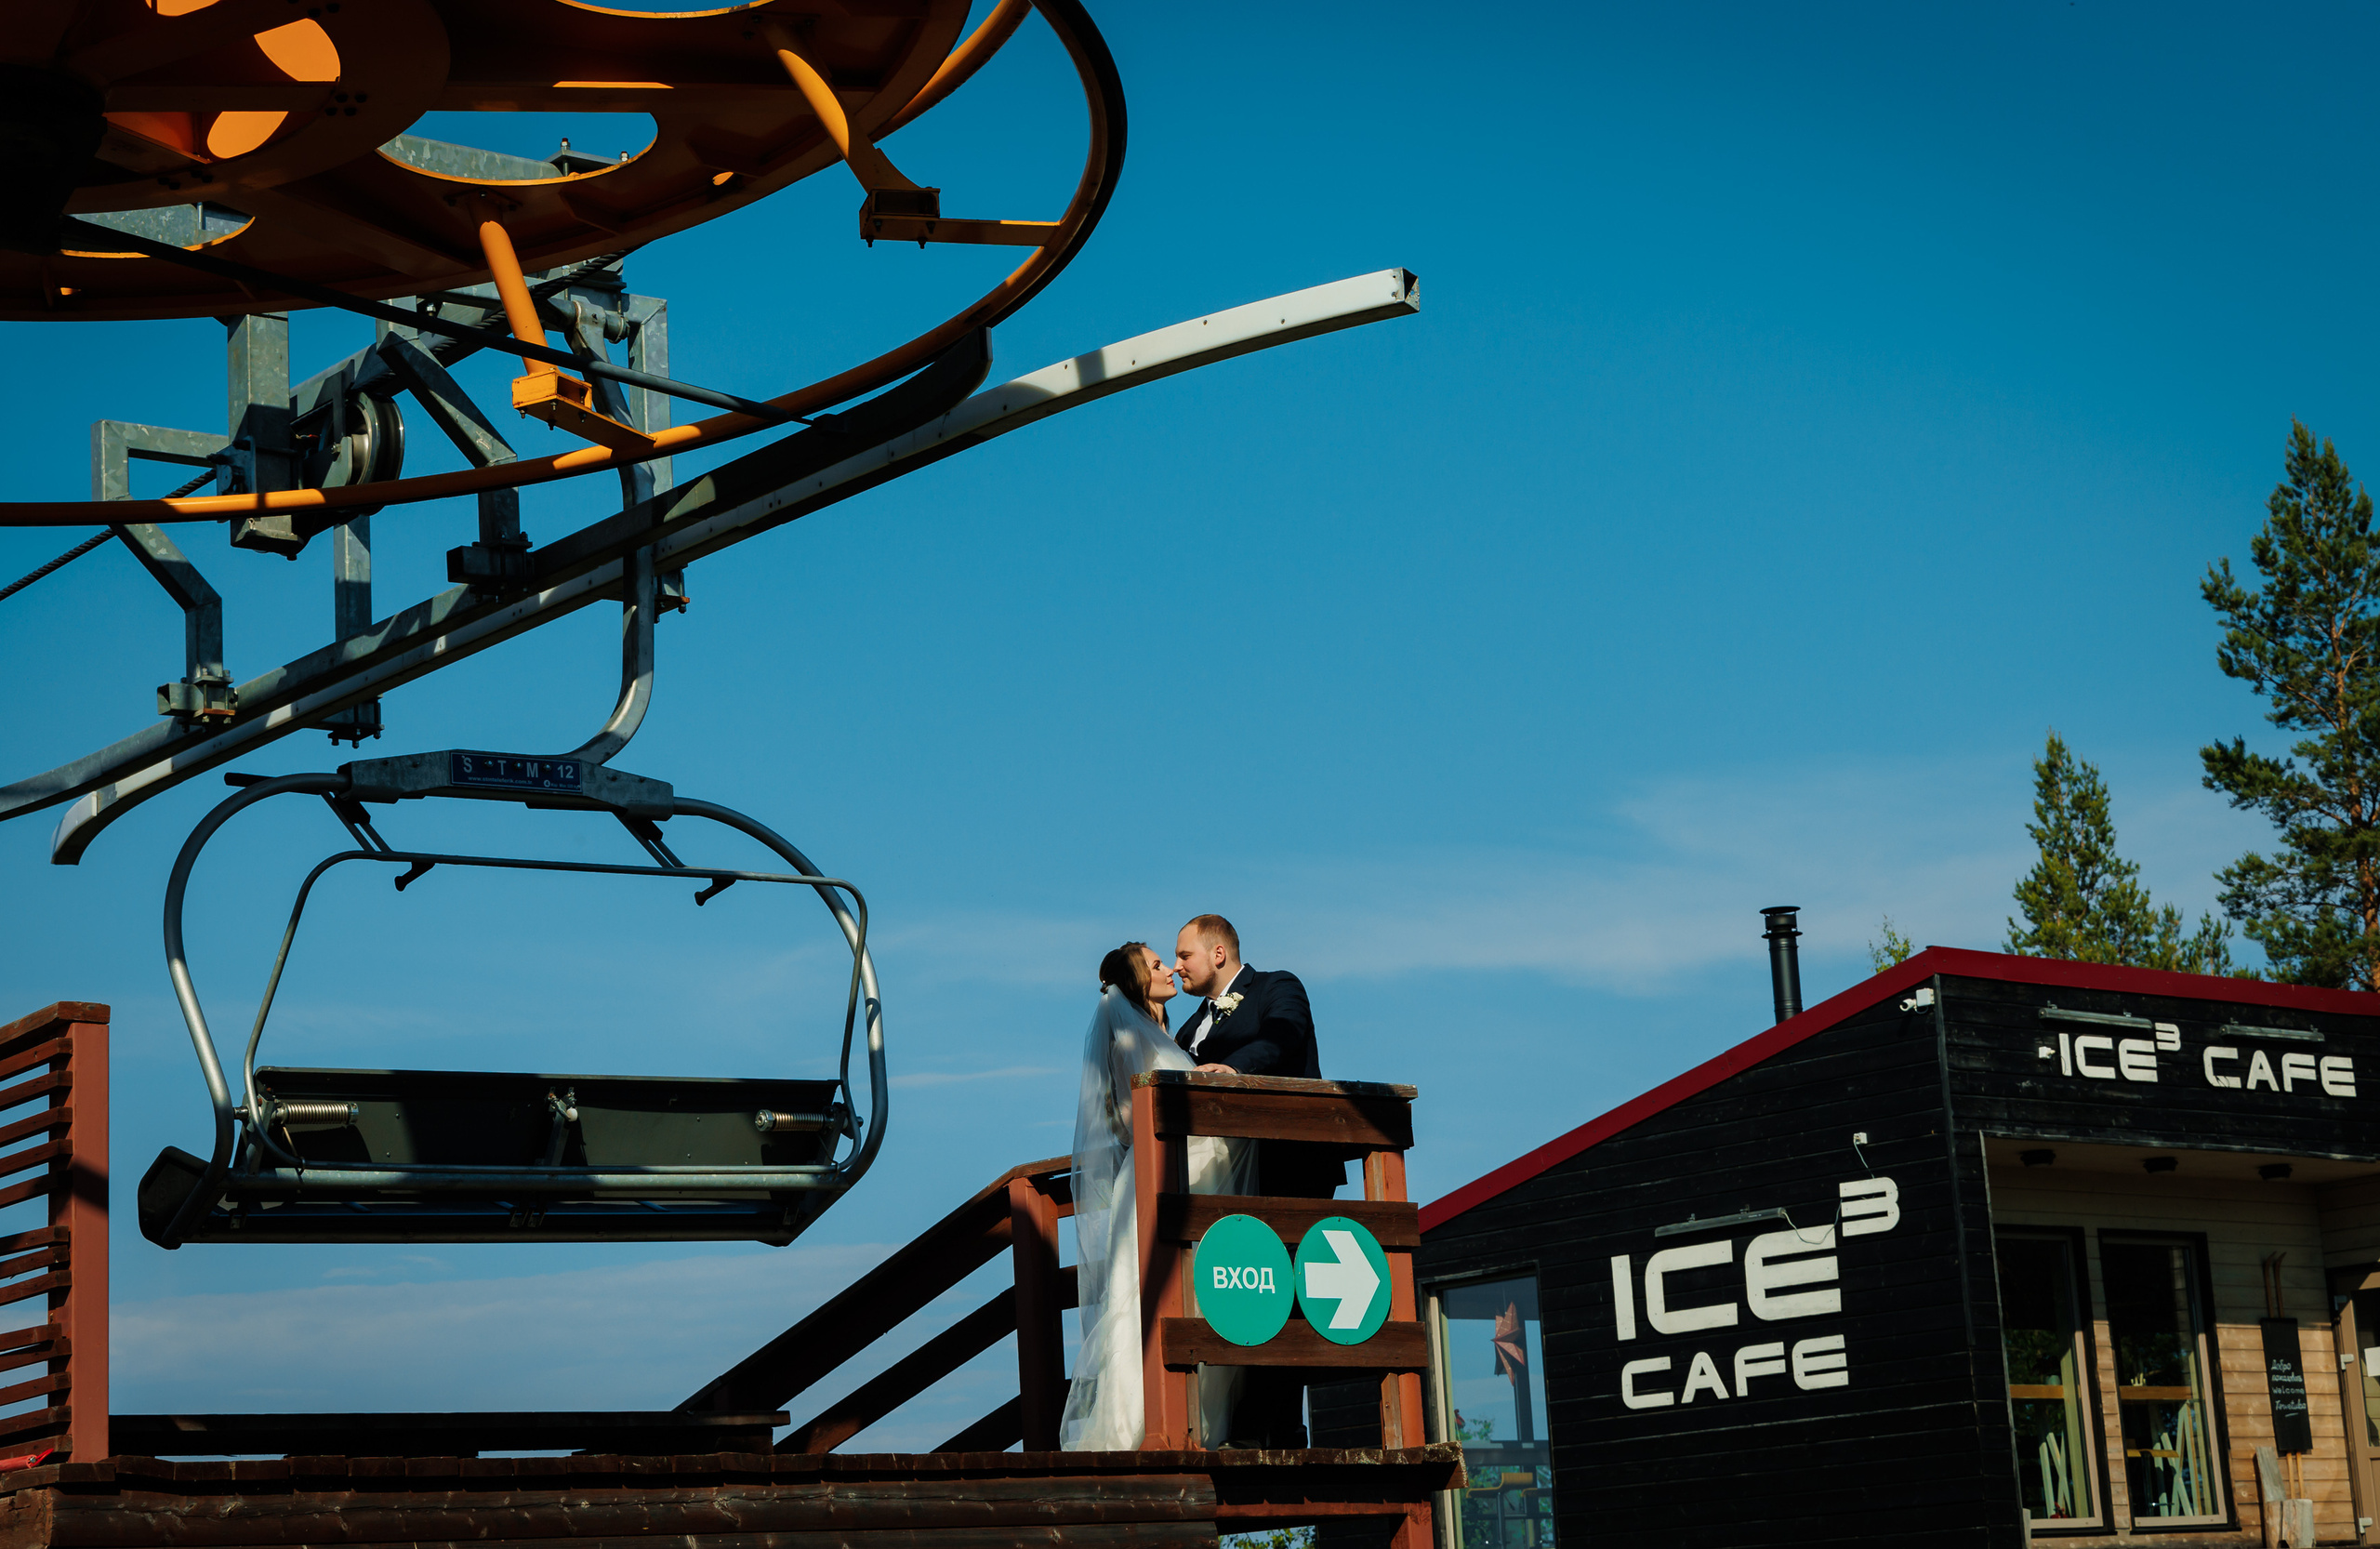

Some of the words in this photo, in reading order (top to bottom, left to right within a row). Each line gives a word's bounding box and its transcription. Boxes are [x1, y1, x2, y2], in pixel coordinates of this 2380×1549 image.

[463, 757, 473, 774] S
[497, 760, 507, 775] T
[526, 762, 539, 778] M
[557, 764, 575, 779] 12
[2202, 1045, 2358, 1098] CAFE
[1212, 1265, 1276, 1294] ВХОД
[1621, 1333, 1849, 1410] CAFE
